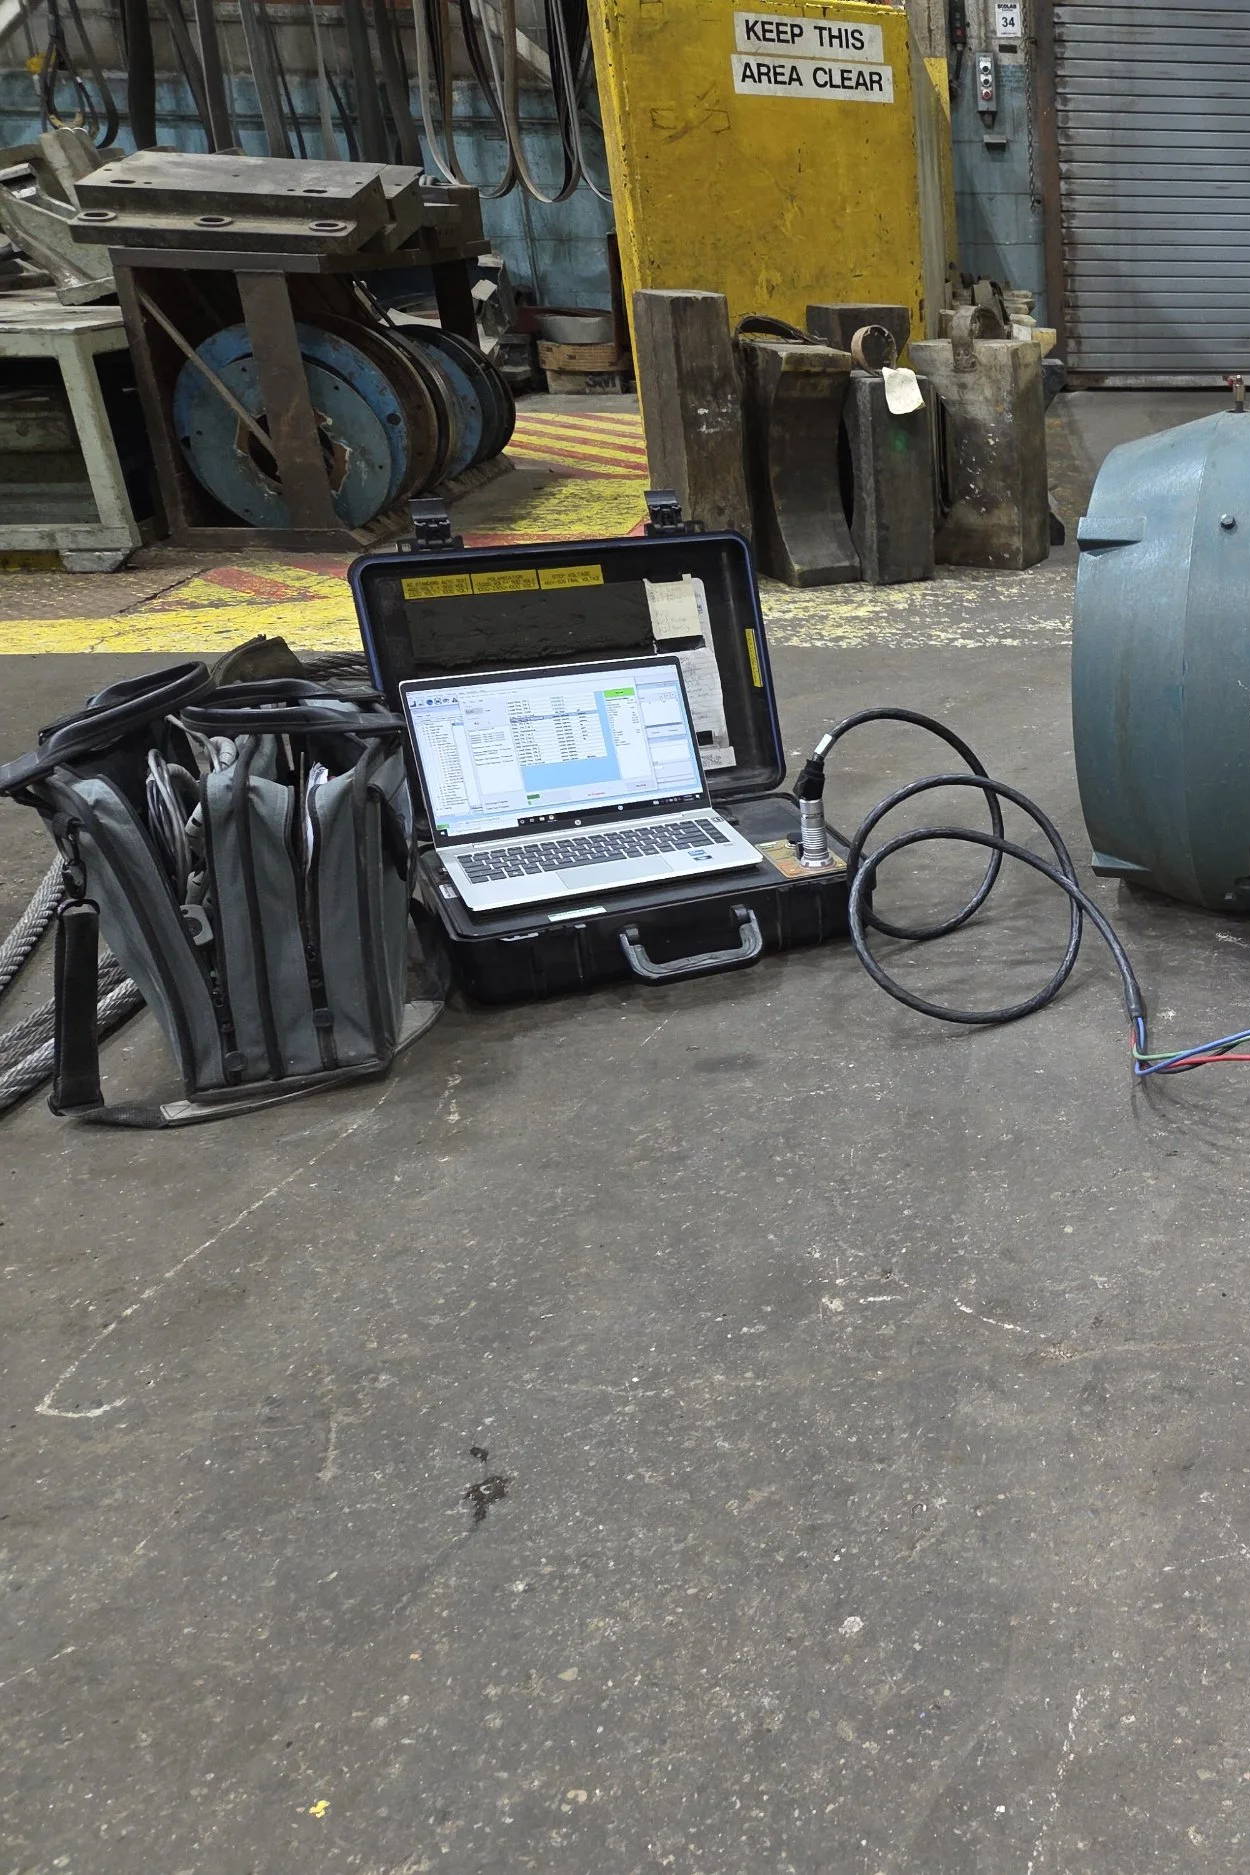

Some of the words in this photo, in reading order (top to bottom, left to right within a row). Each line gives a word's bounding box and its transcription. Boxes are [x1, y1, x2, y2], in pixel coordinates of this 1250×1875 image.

[744, 19, 804, 45] KEEP
[813, 25, 865, 51] THIS
[1001, 16, 1016, 28] 34
[741, 62, 804, 87] AREA
[813, 67, 884, 92] CLEAR
